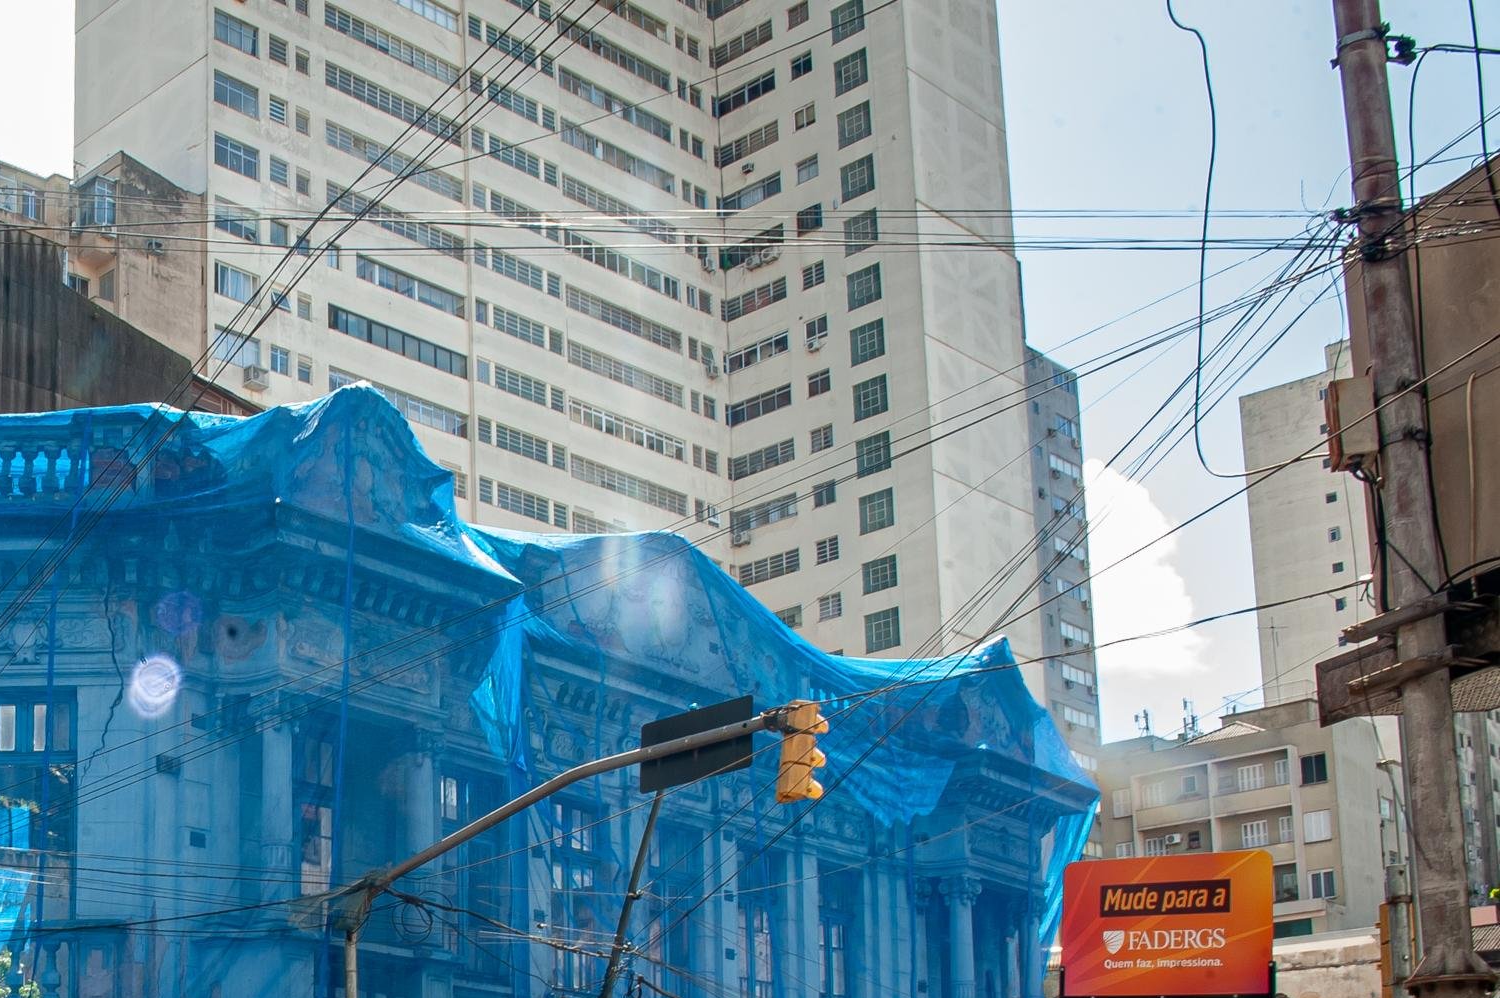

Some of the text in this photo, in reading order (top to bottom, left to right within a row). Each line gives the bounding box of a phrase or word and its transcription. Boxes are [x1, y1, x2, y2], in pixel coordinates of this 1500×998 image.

[1104, 887, 1226, 912] Mude para a
[1128, 928, 1226, 950] FADERGS
[1104, 958, 1224, 969] Quem faz, impressiona.
